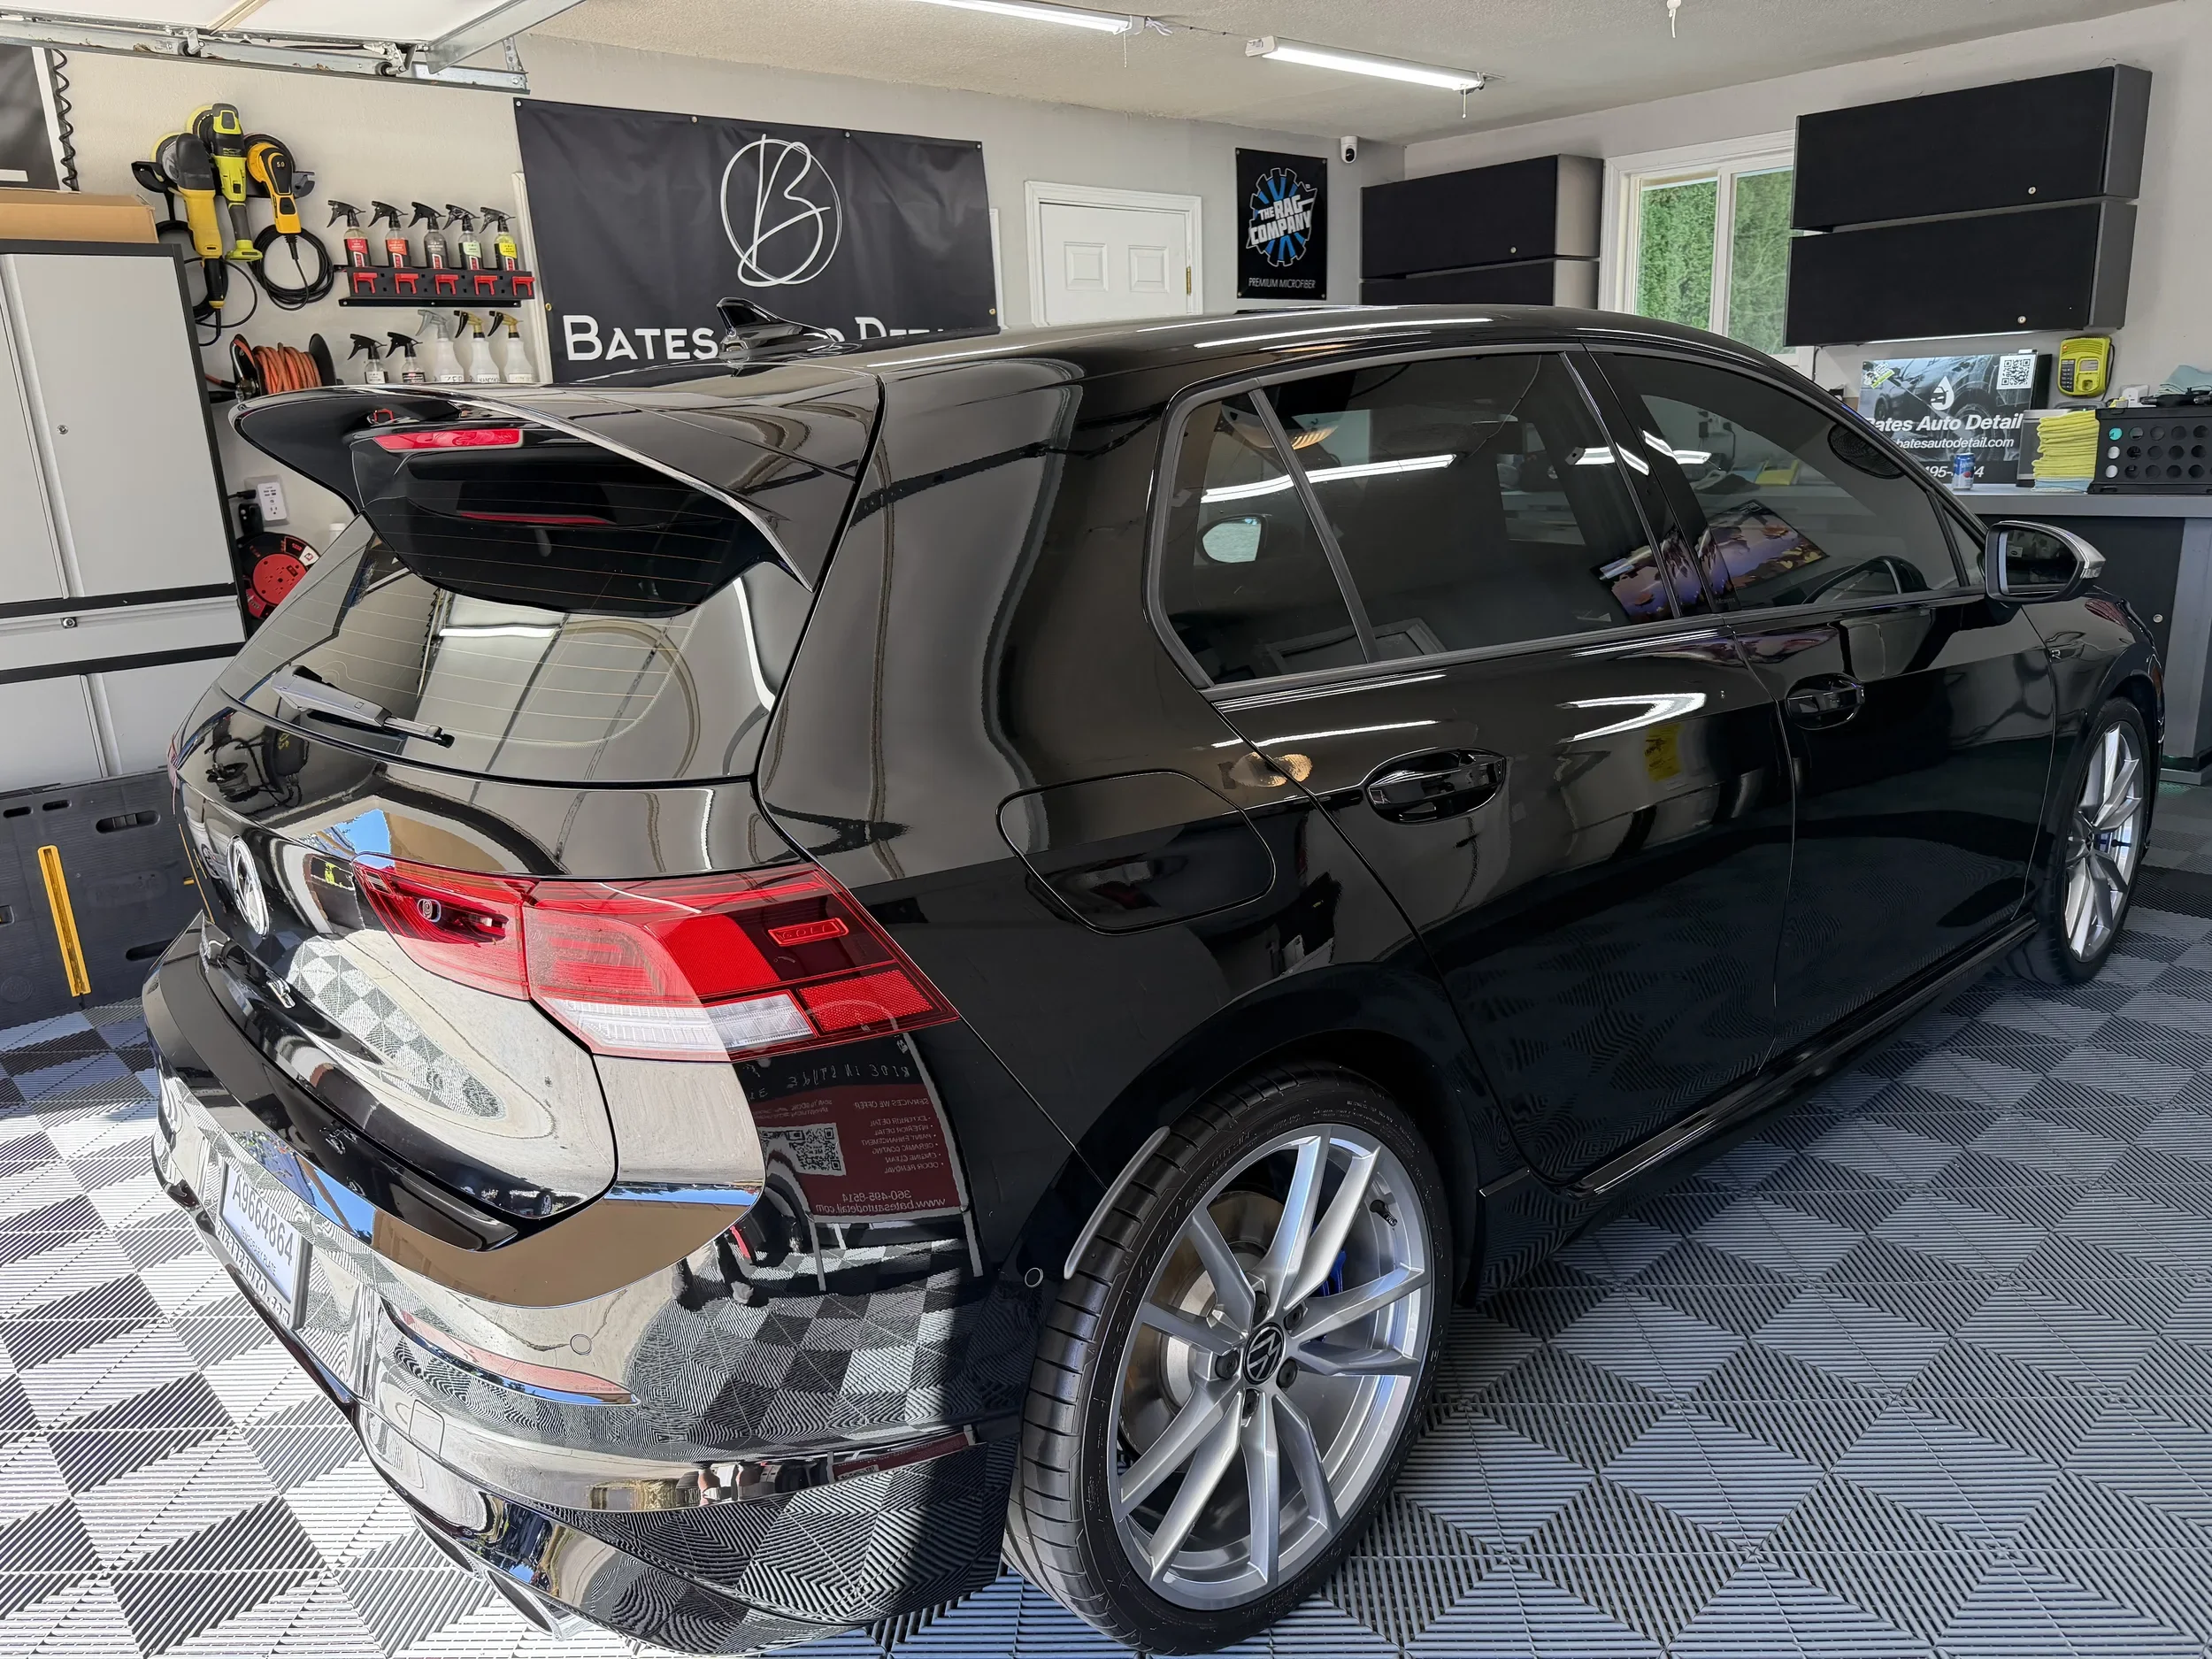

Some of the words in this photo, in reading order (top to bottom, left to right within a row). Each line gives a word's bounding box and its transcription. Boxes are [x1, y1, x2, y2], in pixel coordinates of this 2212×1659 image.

[1258, 206, 1275, 220] THE
[1273, 195, 1314, 219] RAG
[1249, 210, 1311, 245] COMPANY
[1248, 278, 1278, 288] PREMIUM
[1279, 279, 1316, 288] MICROFIBER
[562, 314, 718, 361] BATES
[1916, 415, 1961, 431] Auto
[1965, 413, 2024, 429] Detail
[232, 1175, 294, 1265] A9664864
